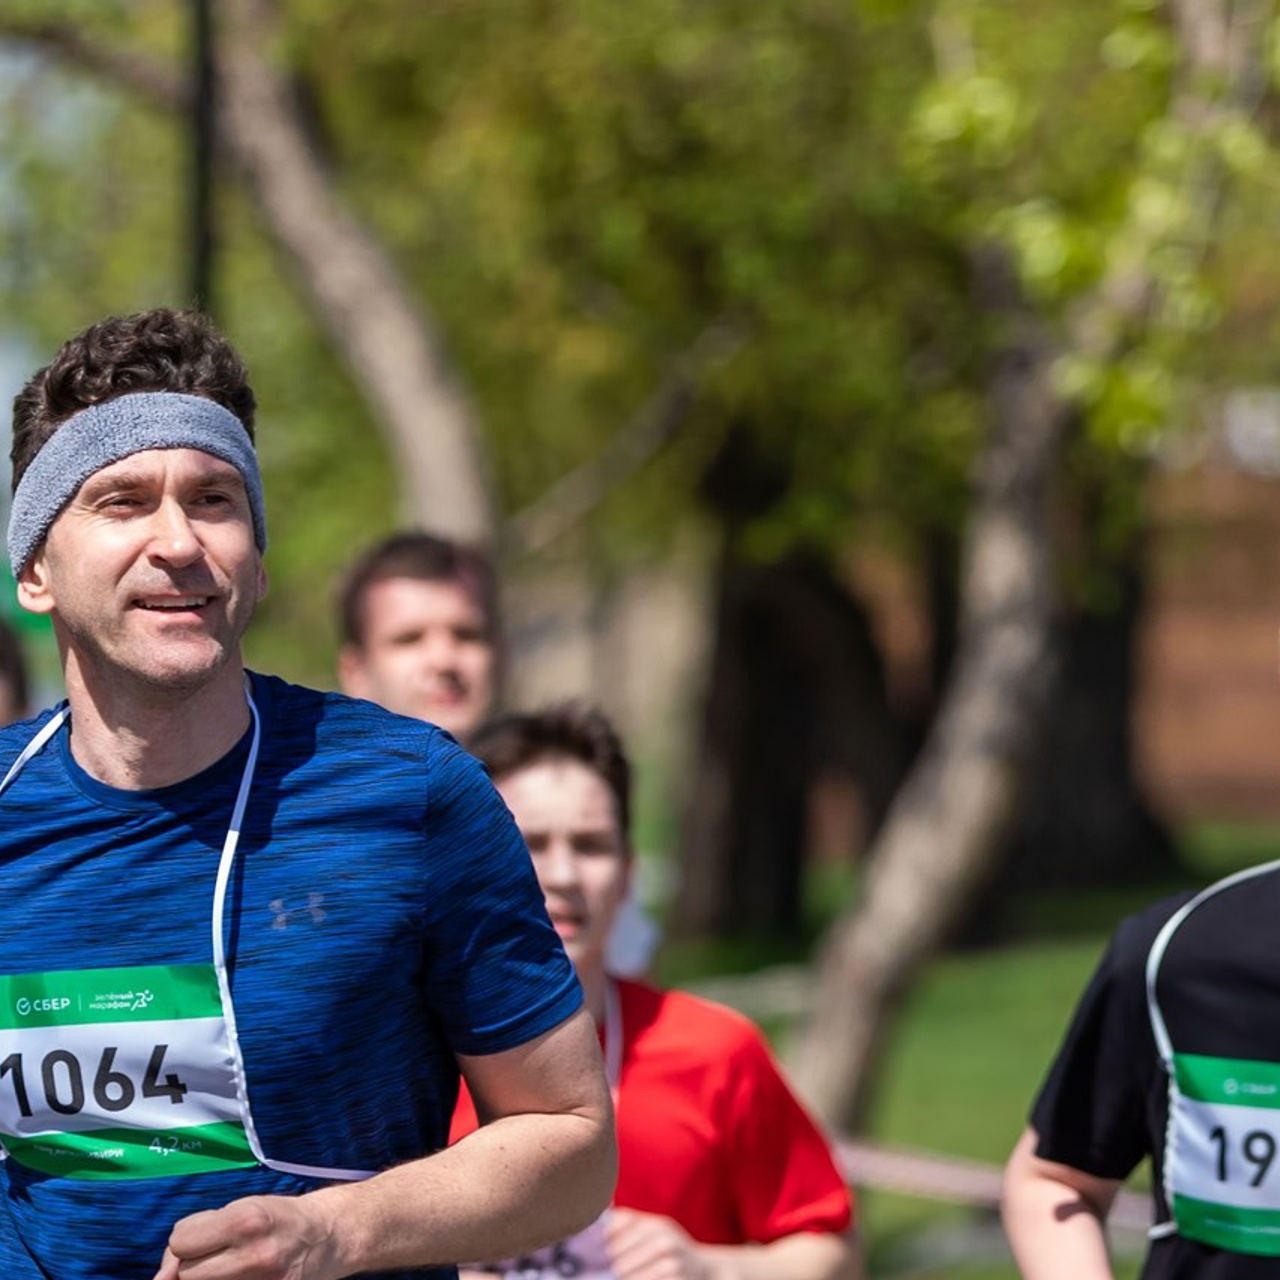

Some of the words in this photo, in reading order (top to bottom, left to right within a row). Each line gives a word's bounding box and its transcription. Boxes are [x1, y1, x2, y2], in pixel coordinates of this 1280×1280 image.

[33, 997, 70, 1011] СБЕР
[0, 1044, 187, 1117] 1064
[149, 1137, 179, 1157] 4,2
[1209, 1126, 1277, 1187] 19
